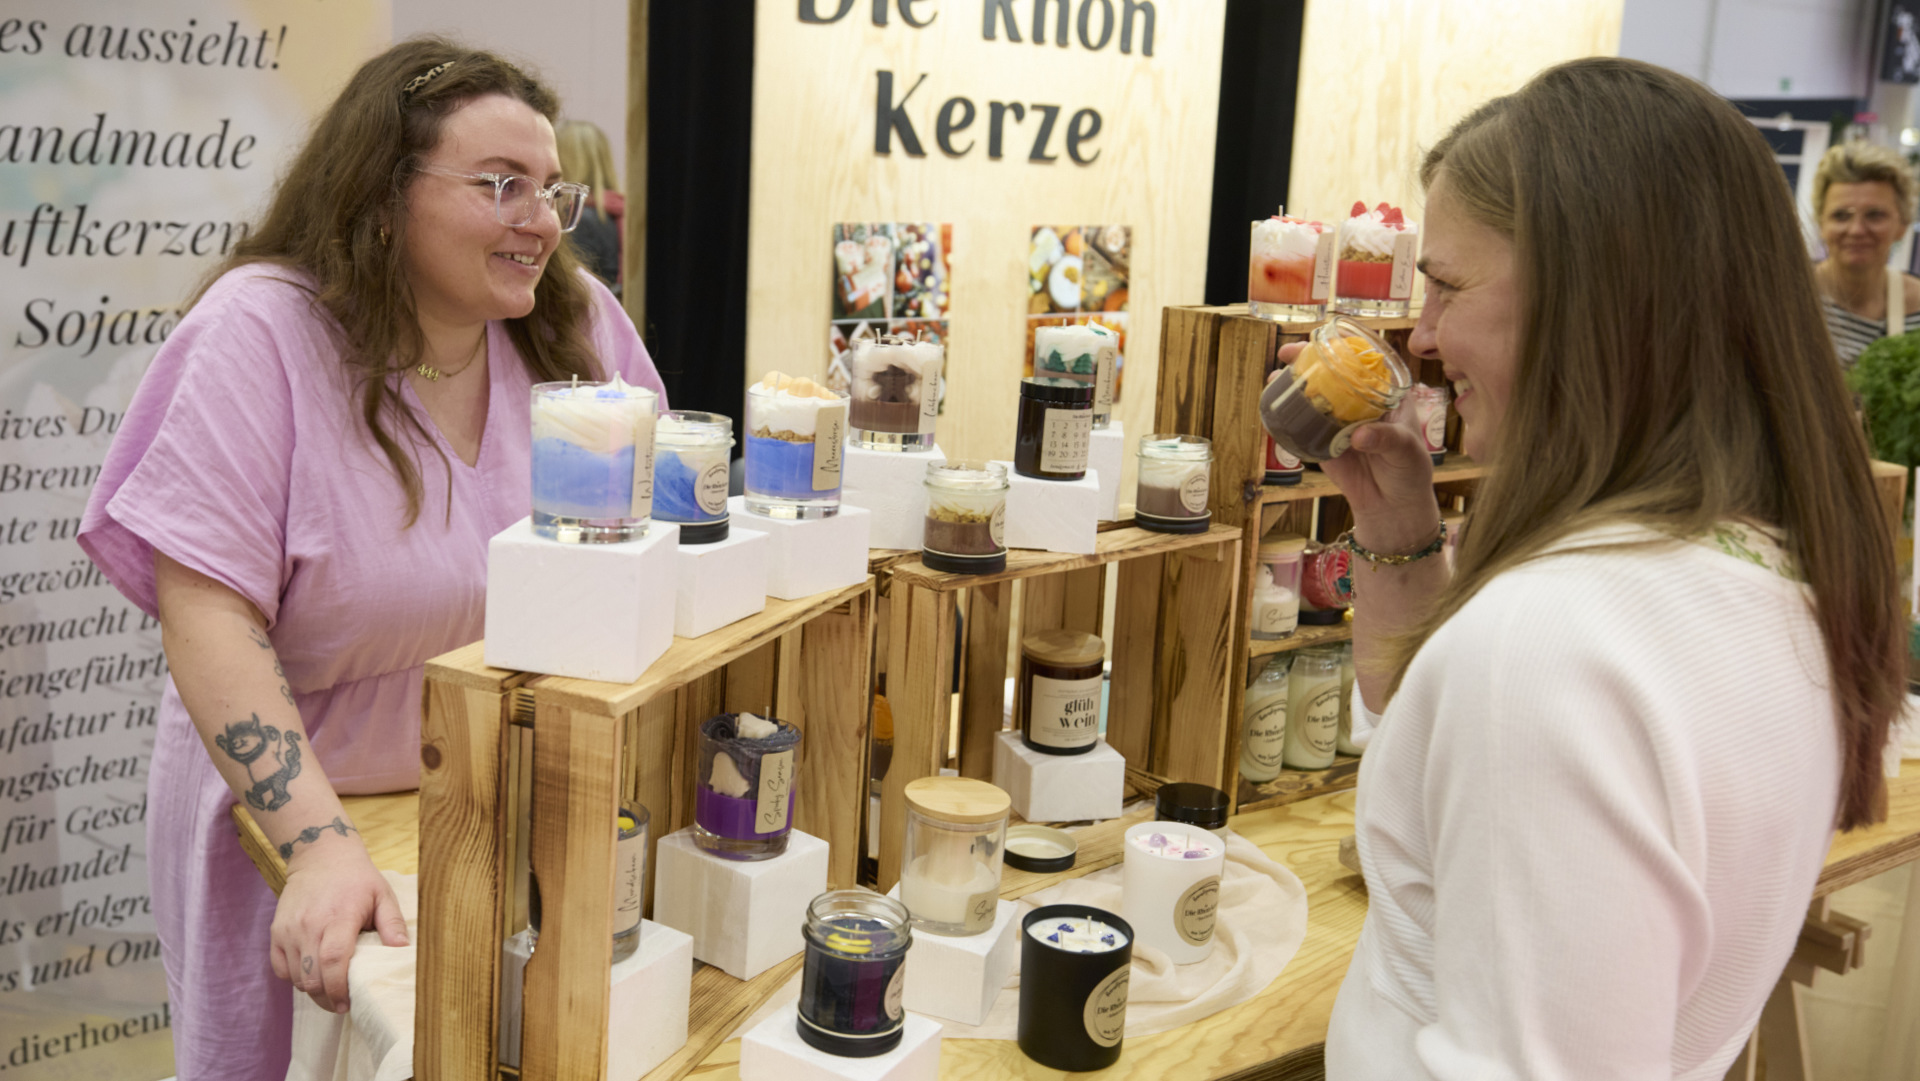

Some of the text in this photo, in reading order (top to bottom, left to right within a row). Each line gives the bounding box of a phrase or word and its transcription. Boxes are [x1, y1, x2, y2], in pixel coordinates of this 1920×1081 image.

[0, 18, 288, 70] es aussieht!
[0, 113, 257, 170] andmade
[874, 69, 1103, 167] Kerze
[124, 700, 156, 730] in
[0, 814, 56, 855] für
[30, 944, 96, 987] und
